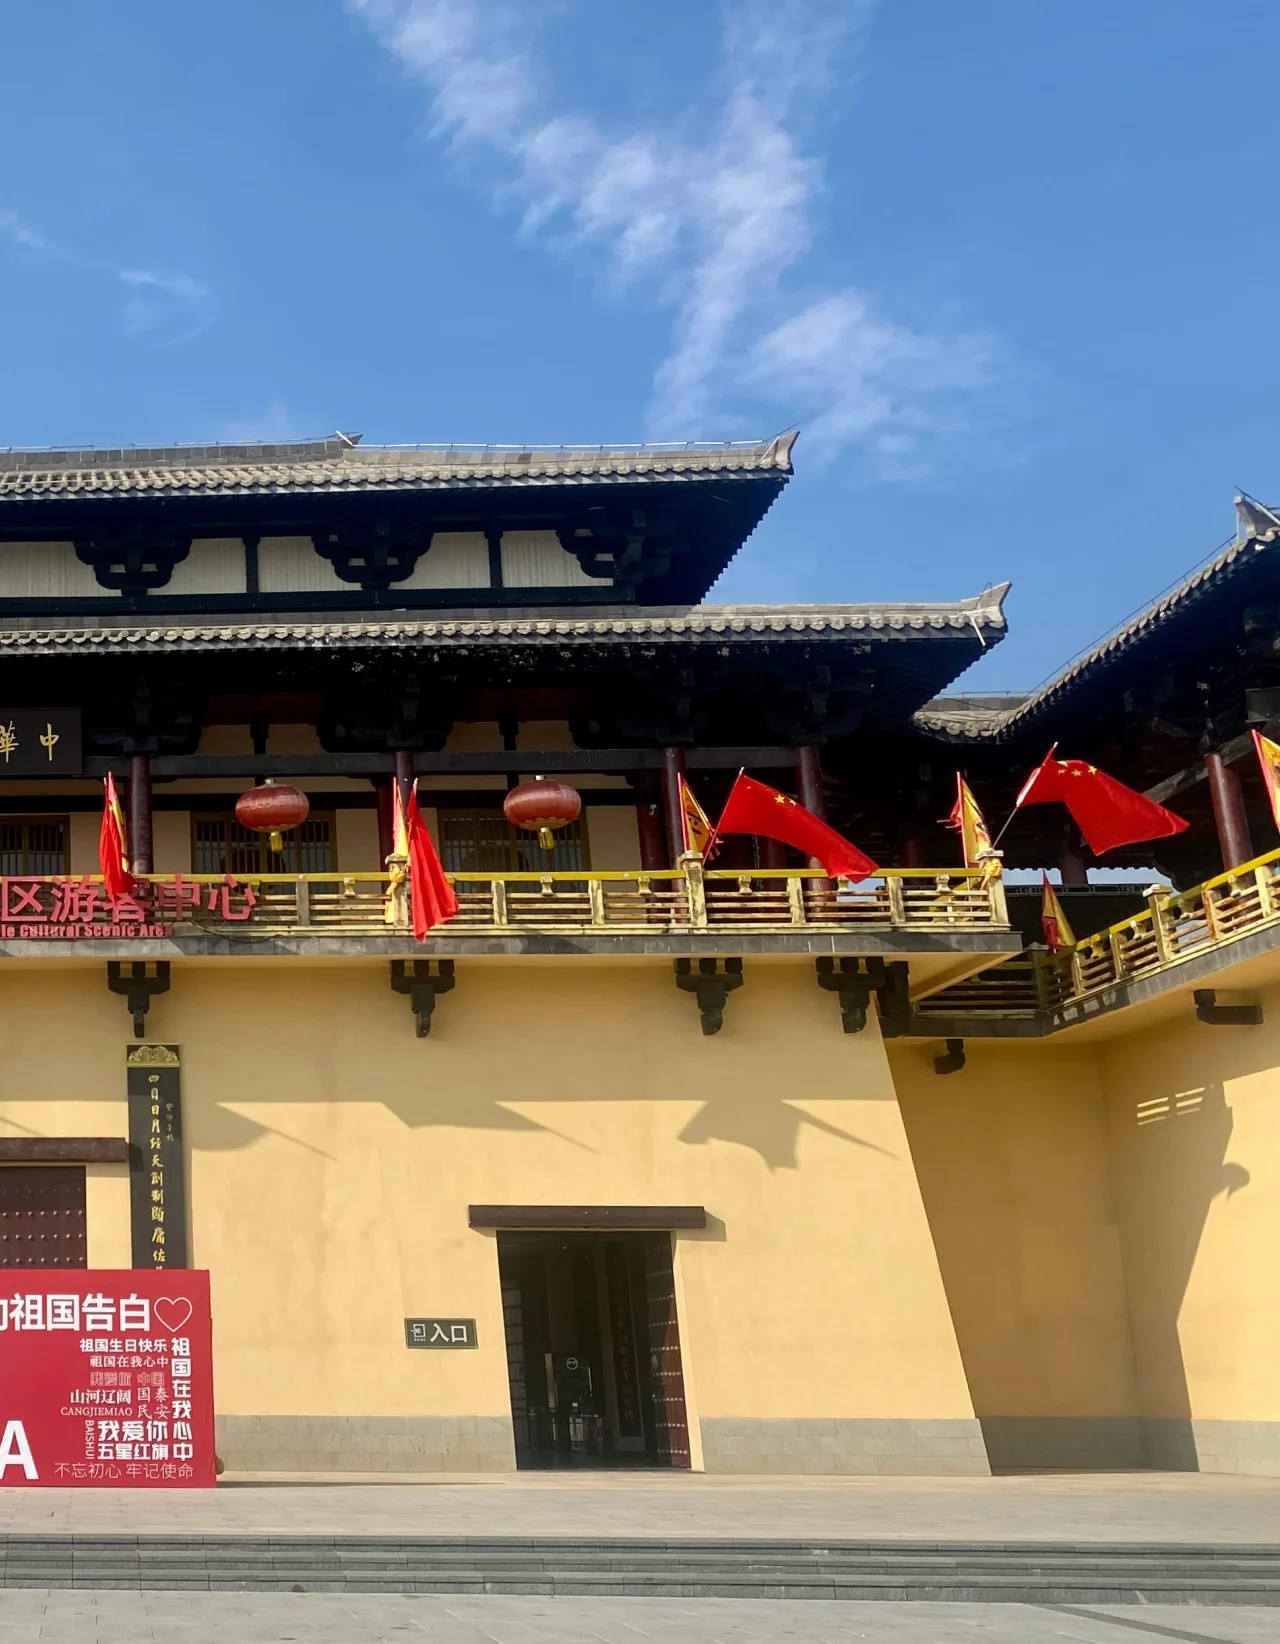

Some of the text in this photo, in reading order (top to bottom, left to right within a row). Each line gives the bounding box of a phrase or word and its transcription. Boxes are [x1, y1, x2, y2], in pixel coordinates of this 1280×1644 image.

[20, 924, 79, 938] Cultural
[84, 923, 136, 938] Scenic
[139, 923, 174, 937] Area
[429, 1322, 468, 1343] 入口
[79, 1338, 168, 1353] 祖国生日快乐
[90, 1355, 169, 1368] 祖国在我心中
[90, 1372, 165, 1387] 我爱你 中国
[70, 1389, 132, 1405] 山河辽阔
[171, 1337, 194, 1462] 祖国在我心中
[60, 1406, 133, 1417] CANGJIEMIAO
[97, 1420, 169, 1442] 我爱你
[85, 1420, 95, 1460] BAISHUI
[97, 1443, 169, 1461] 五星红旗
[54, 1462, 194, 1479] 不忘初心 牢记使命
